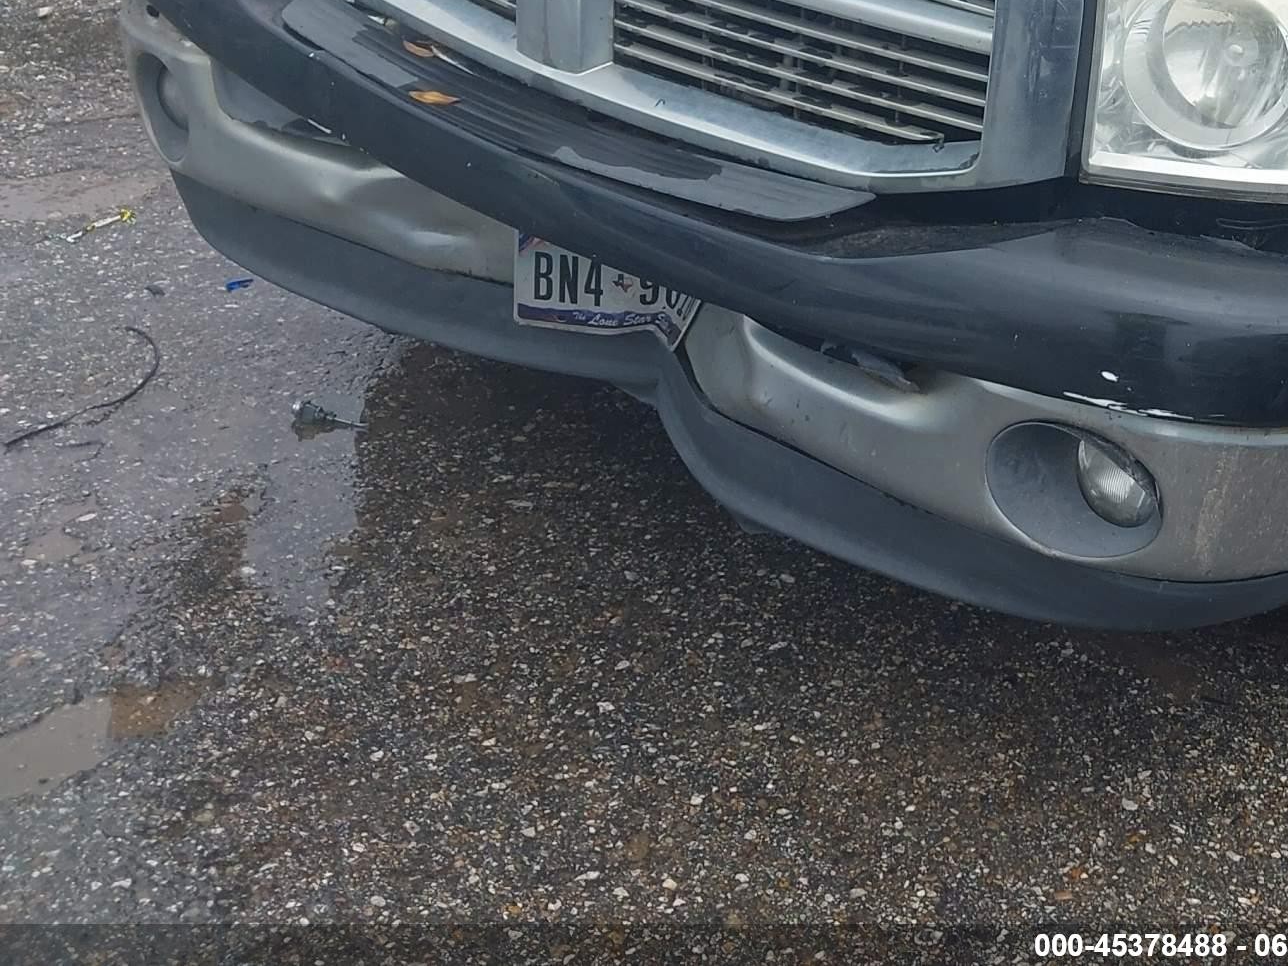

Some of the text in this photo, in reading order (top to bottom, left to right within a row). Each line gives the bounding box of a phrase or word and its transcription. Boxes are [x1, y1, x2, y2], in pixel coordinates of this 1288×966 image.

[533, 251, 604, 307] BN4
[587, 313, 619, 327] Lone
[623, 313, 652, 326] Star
